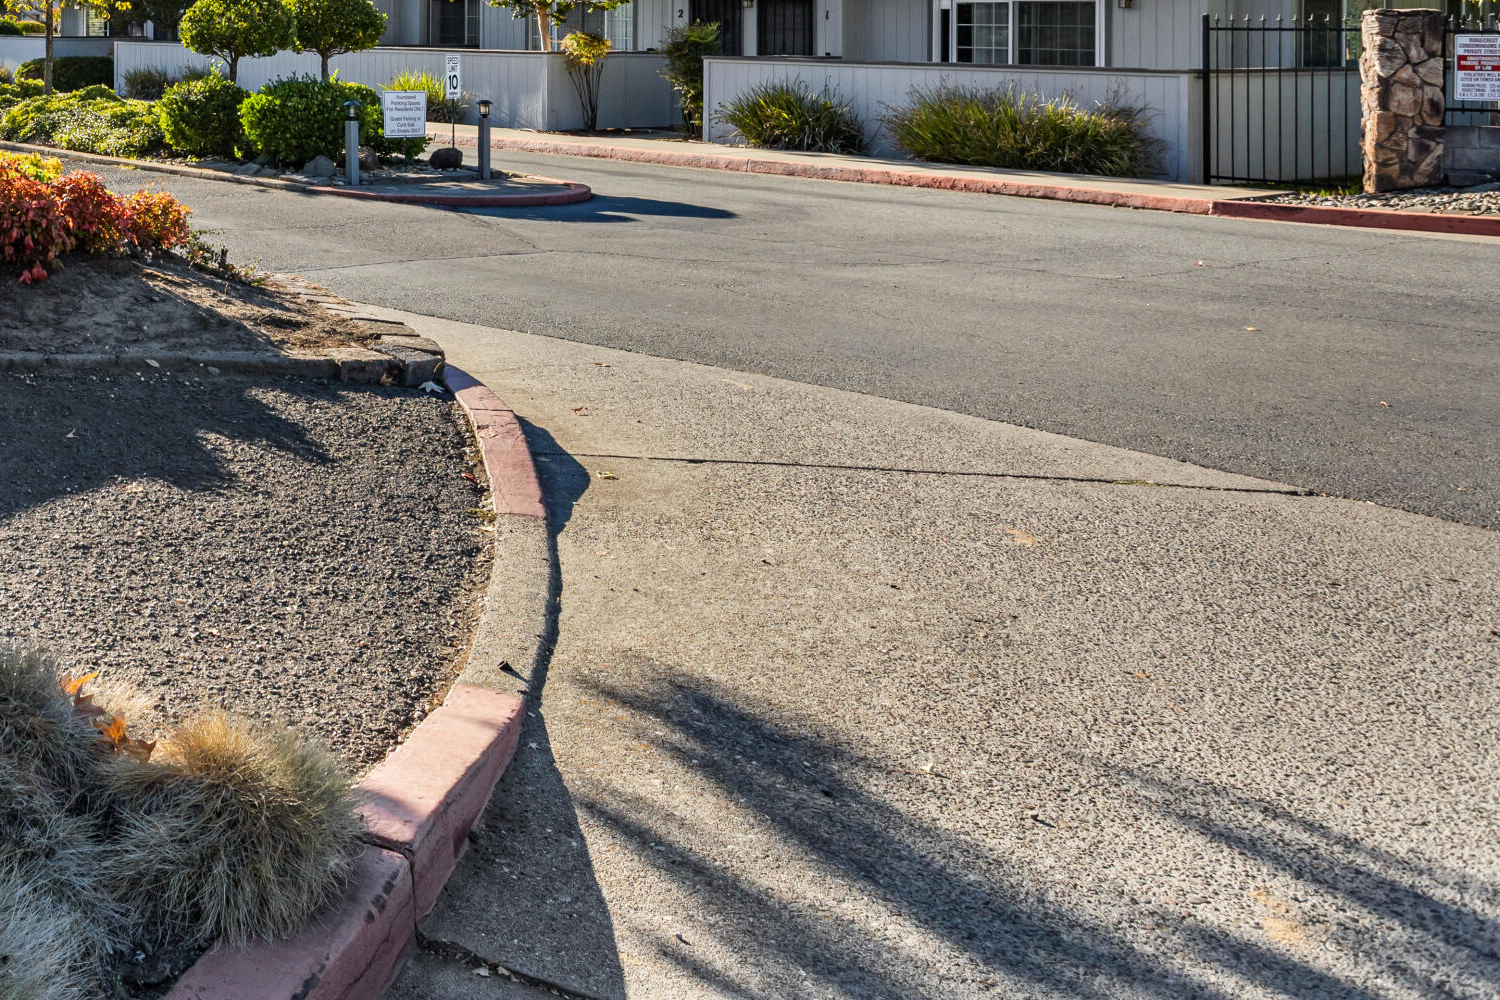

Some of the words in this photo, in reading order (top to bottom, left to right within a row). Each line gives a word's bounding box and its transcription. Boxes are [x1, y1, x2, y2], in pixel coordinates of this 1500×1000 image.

[678, 9, 684, 18] 2
[447, 56, 459, 64] SPEED
[448, 74, 458, 90] 10
